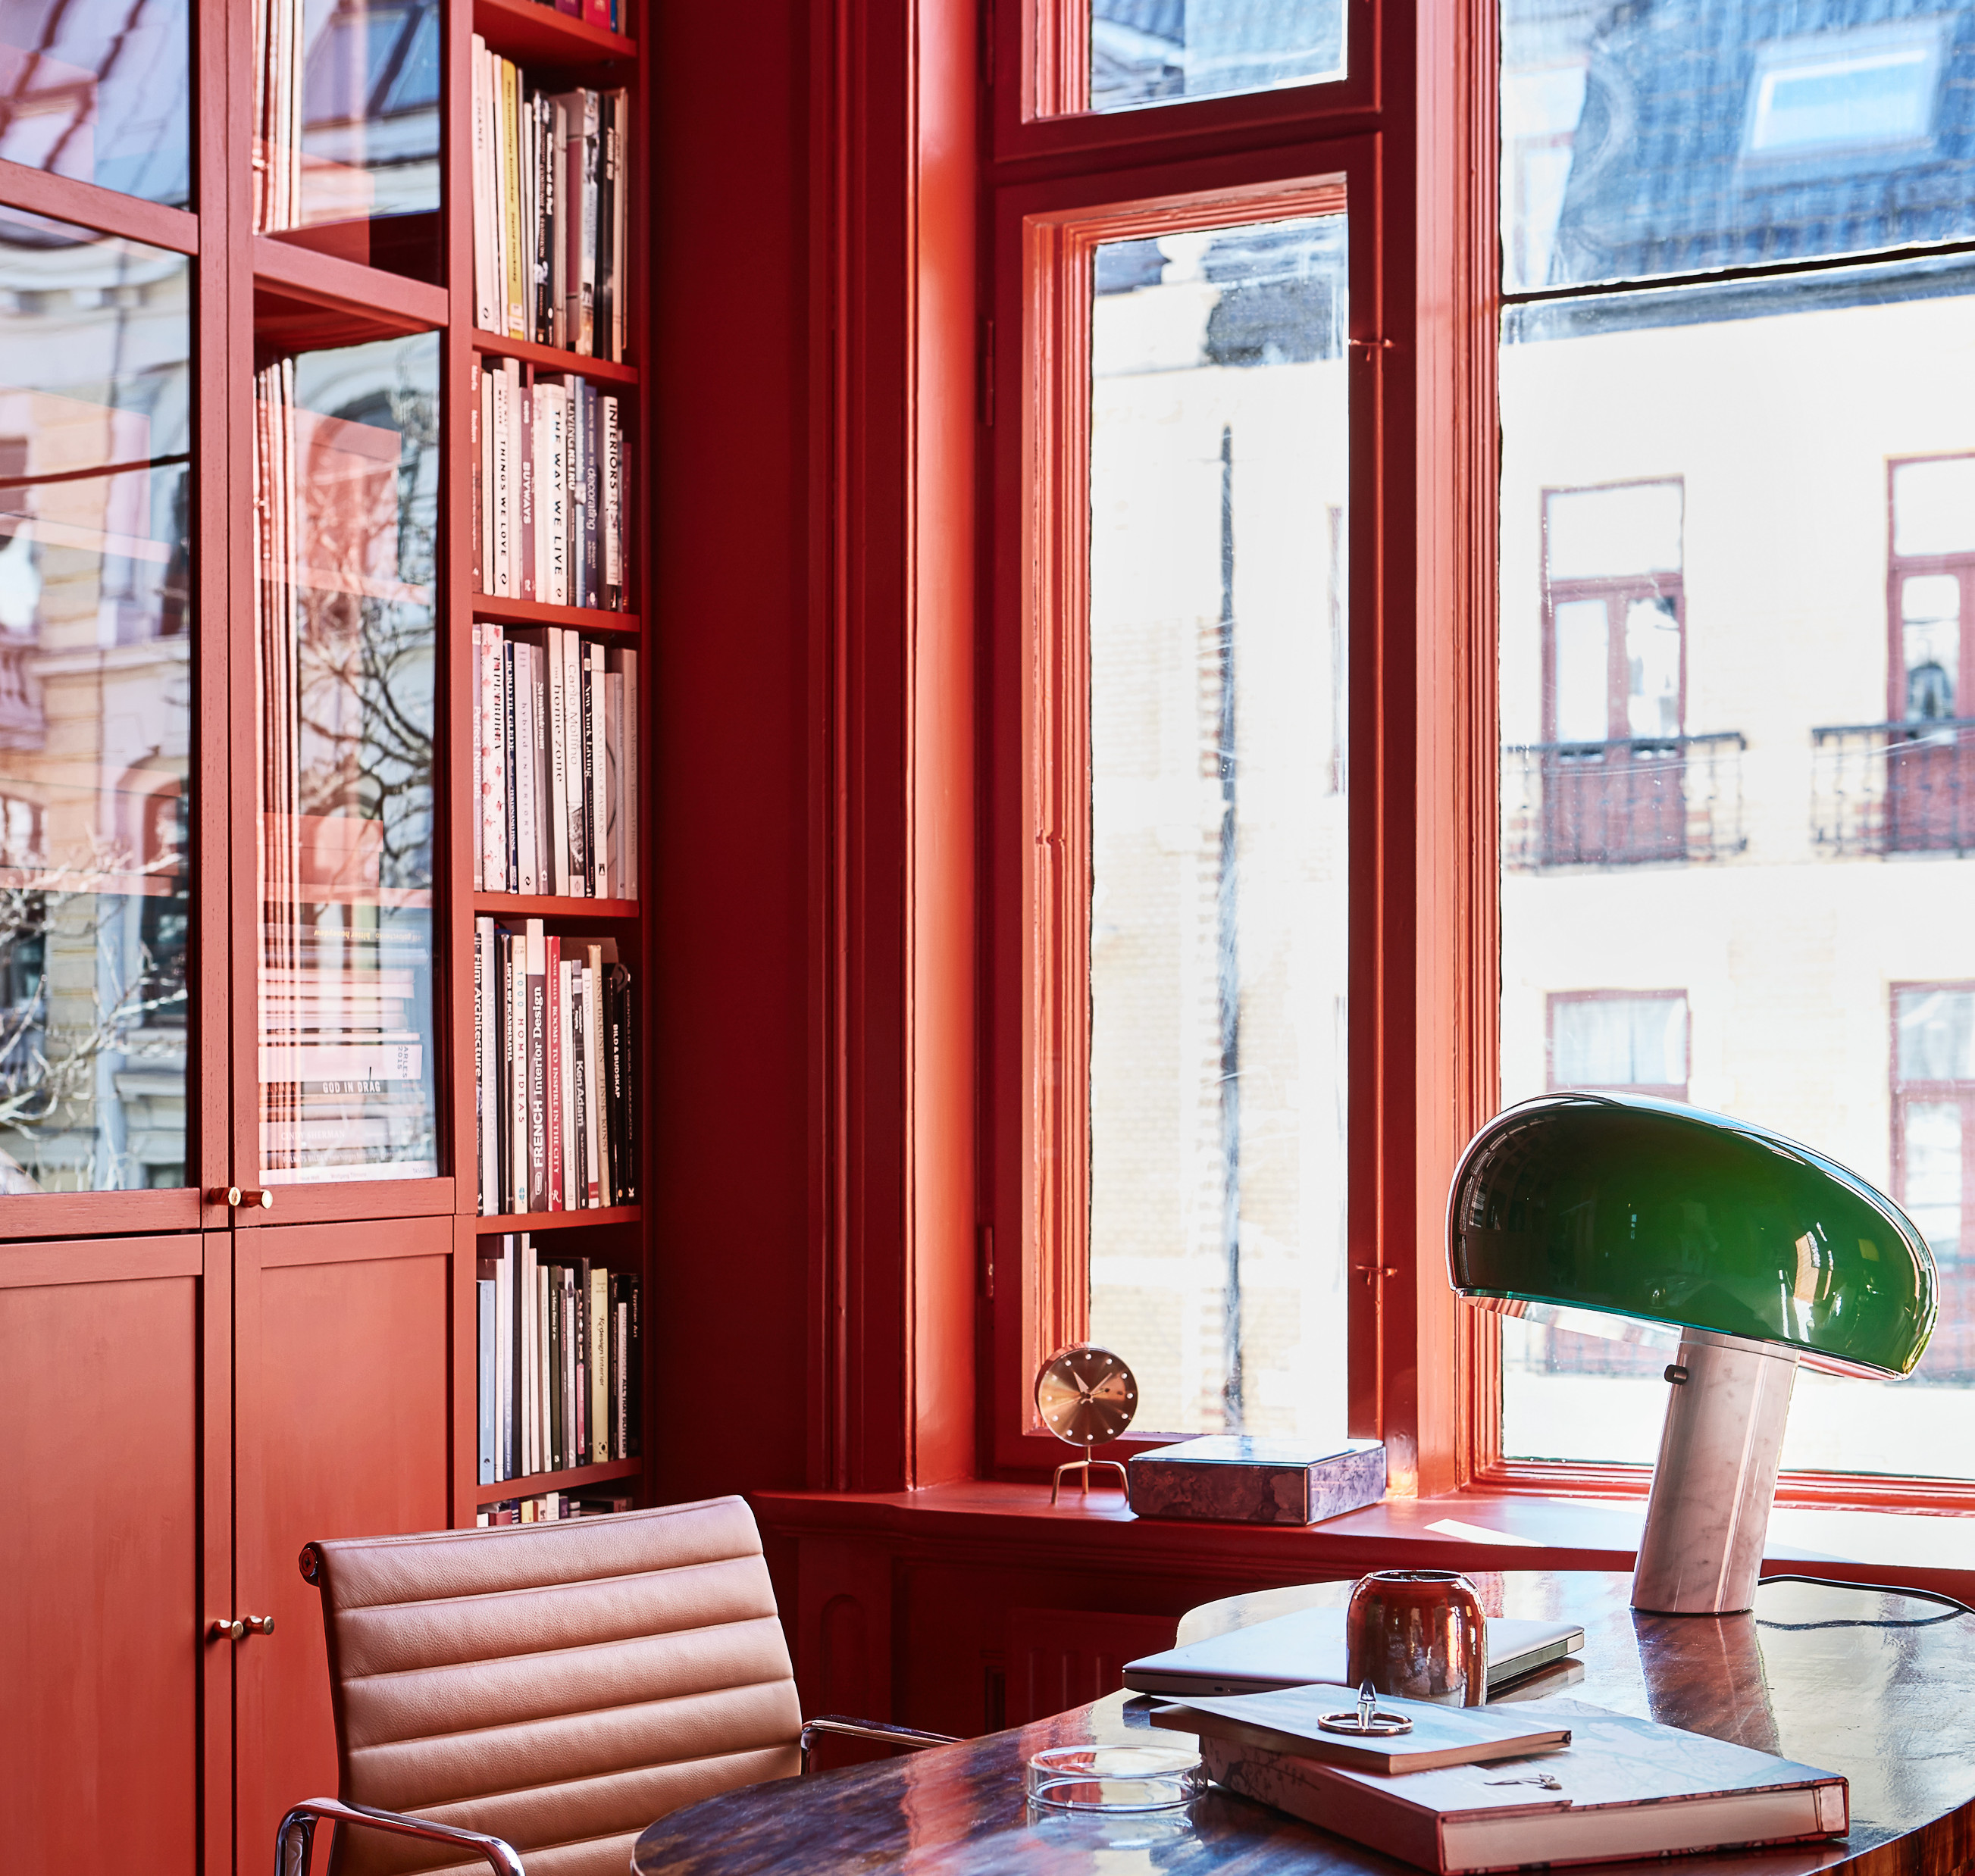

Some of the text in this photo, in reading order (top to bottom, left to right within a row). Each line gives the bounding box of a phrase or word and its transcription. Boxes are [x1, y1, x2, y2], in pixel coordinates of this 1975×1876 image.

[567, 402, 576, 447] LIVING
[588, 456, 594, 466] TO
[609, 404, 618, 490] INTERIORS
[500, 497, 507, 516] WE
[522, 461, 531, 524] BUYWAYS
[554, 500, 562, 528] WE
[585, 467, 597, 530] decorating
[554, 536, 562, 576] LIVE
[473, 705, 481, 749] Perfect
[553, 685, 562, 733] home
[568, 664, 581, 765] Carlo Mollino
[507, 714, 515, 752] GLEDE
[473, 751, 482, 800] Neutrals
[554, 740, 563, 782] zone
[584, 741, 593, 777] Living
[474, 953, 483, 1077] Film Architecture
[507, 990, 512, 1002] OF
[532, 986, 543, 1039] Design
[486, 992, 496, 1143] New Paris Interiors
[533, 1043, 543, 1096] Interior
[552, 1046, 559, 1063] TO
[322, 1080, 381, 1093] GOD IN DRAG
[576, 1088, 585, 1127] Adam
[307, 1130, 346, 1140] SHERMAN
[533, 1100, 543, 1168] FRENCH
[553, 1109, 560, 1122] IN
